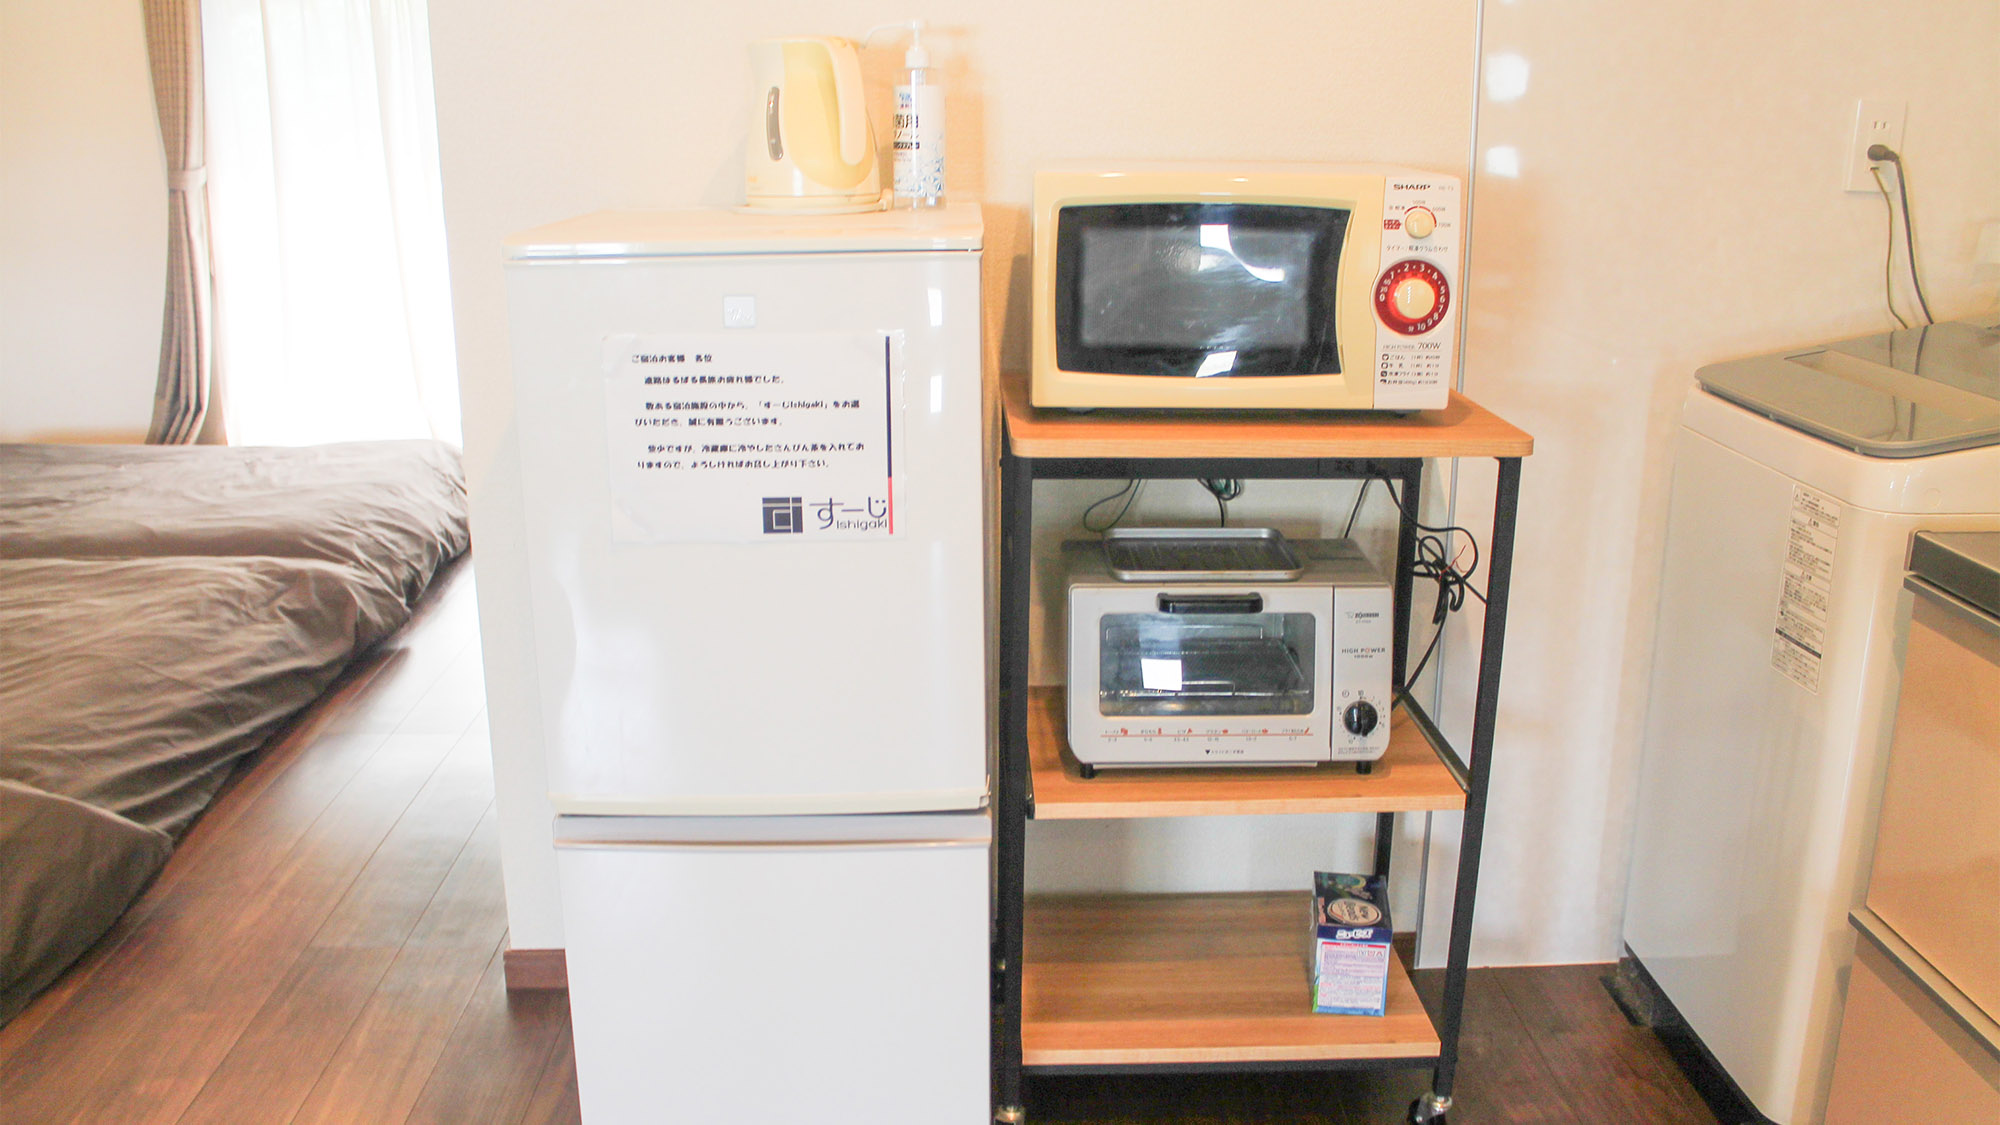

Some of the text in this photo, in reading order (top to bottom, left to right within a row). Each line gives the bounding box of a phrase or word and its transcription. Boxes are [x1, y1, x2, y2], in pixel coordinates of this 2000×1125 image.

[1393, 183, 1431, 191] SHARP
[1403, 263, 1410, 272] 2
[1419, 263, 1426, 272] 3
[1432, 271, 1438, 280] 4
[1440, 285, 1446, 295] 5
[1440, 296, 1446, 304] 6
[1438, 304, 1444, 313] 7
[1432, 312, 1439, 320] 8
[1417, 323, 1426, 331] 10
[1427, 318, 1433, 327] 9
[632, 354, 685, 363] ご宿泊お客様
[809, 496, 887, 530] すーじ
[836, 519, 888, 531] Ishigaki
